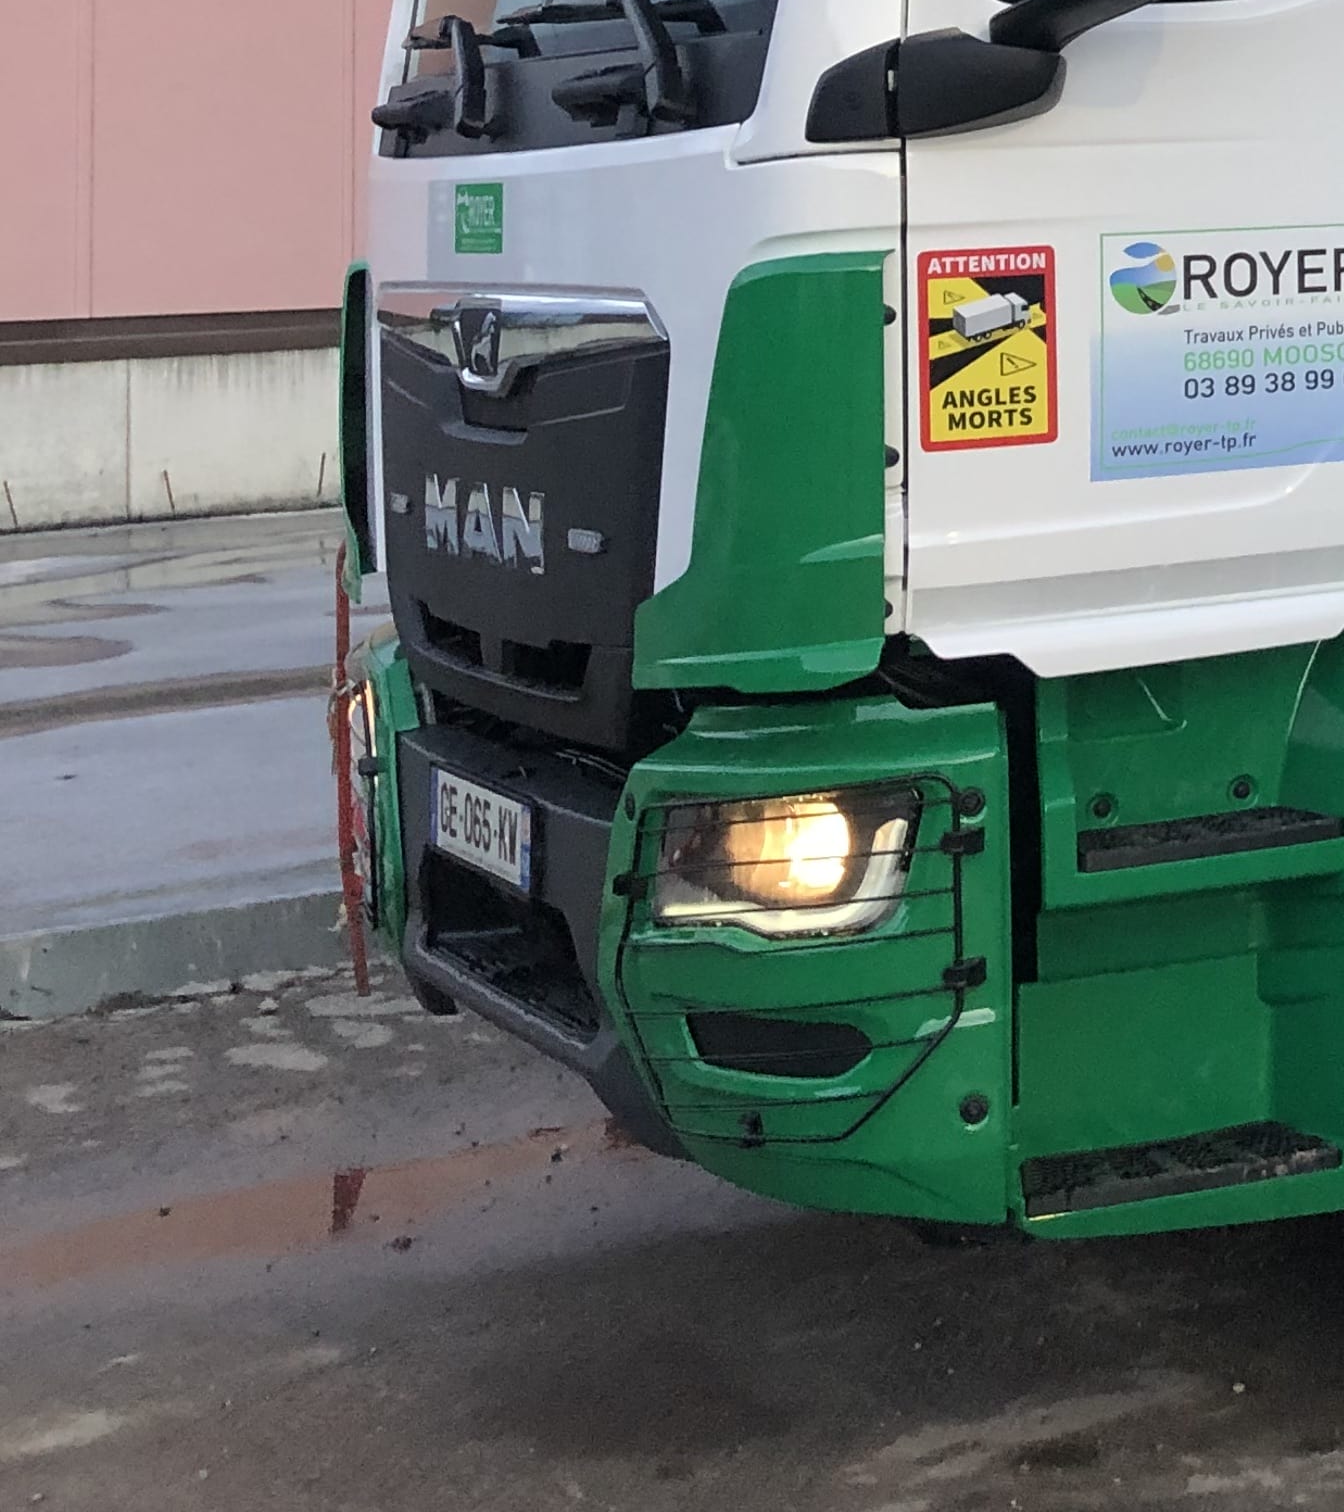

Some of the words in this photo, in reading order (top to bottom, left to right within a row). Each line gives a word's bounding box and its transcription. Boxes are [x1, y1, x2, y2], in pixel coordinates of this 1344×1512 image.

[927, 252, 1047, 275] ATTENTION
[1184, 329, 1244, 344] Travaux
[1249, 323, 1295, 340] Privés
[1299, 323, 1312, 337] et
[1184, 348, 1255, 372] 68690
[1184, 377, 1215, 399] 03
[1225, 374, 1256, 396] 89
[1265, 371, 1296, 394] 38
[1304, 369, 1334, 390] 99
[942, 386, 1037, 410] ANGLES
[948, 407, 1033, 431] MORTS
[1112, 432, 1257, 457] www.royer-tp.fr
[424, 473, 546, 575] MAN
